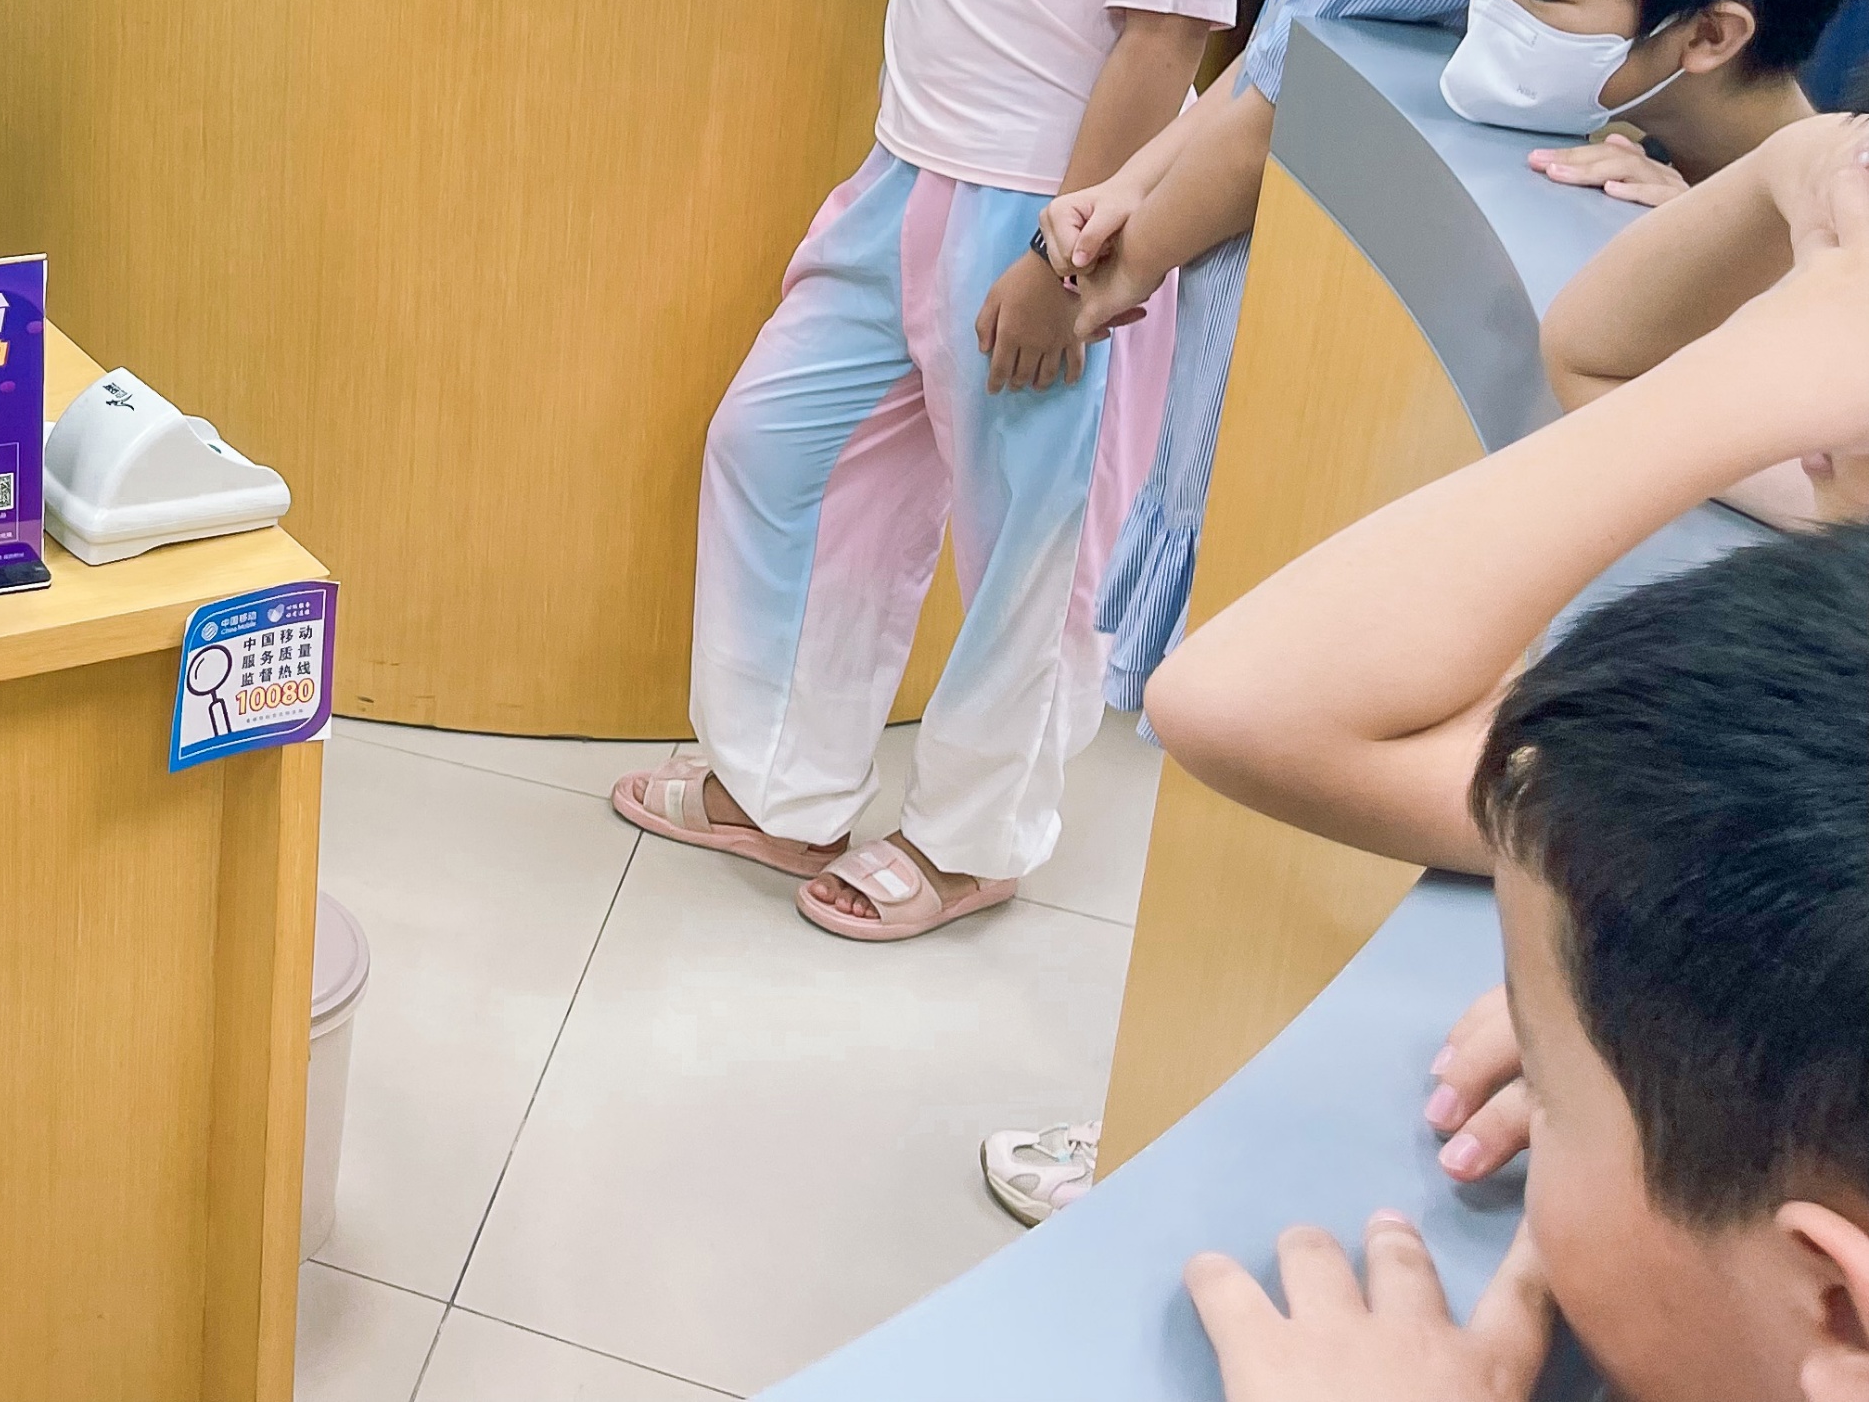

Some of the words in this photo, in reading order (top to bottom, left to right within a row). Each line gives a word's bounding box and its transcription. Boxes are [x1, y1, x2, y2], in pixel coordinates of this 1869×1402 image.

[243, 624, 313, 652] 中国移动
[241, 643, 312, 670] 服务质量
[240, 661, 312, 687] 监督热线
[235, 677, 315, 716] 10080
